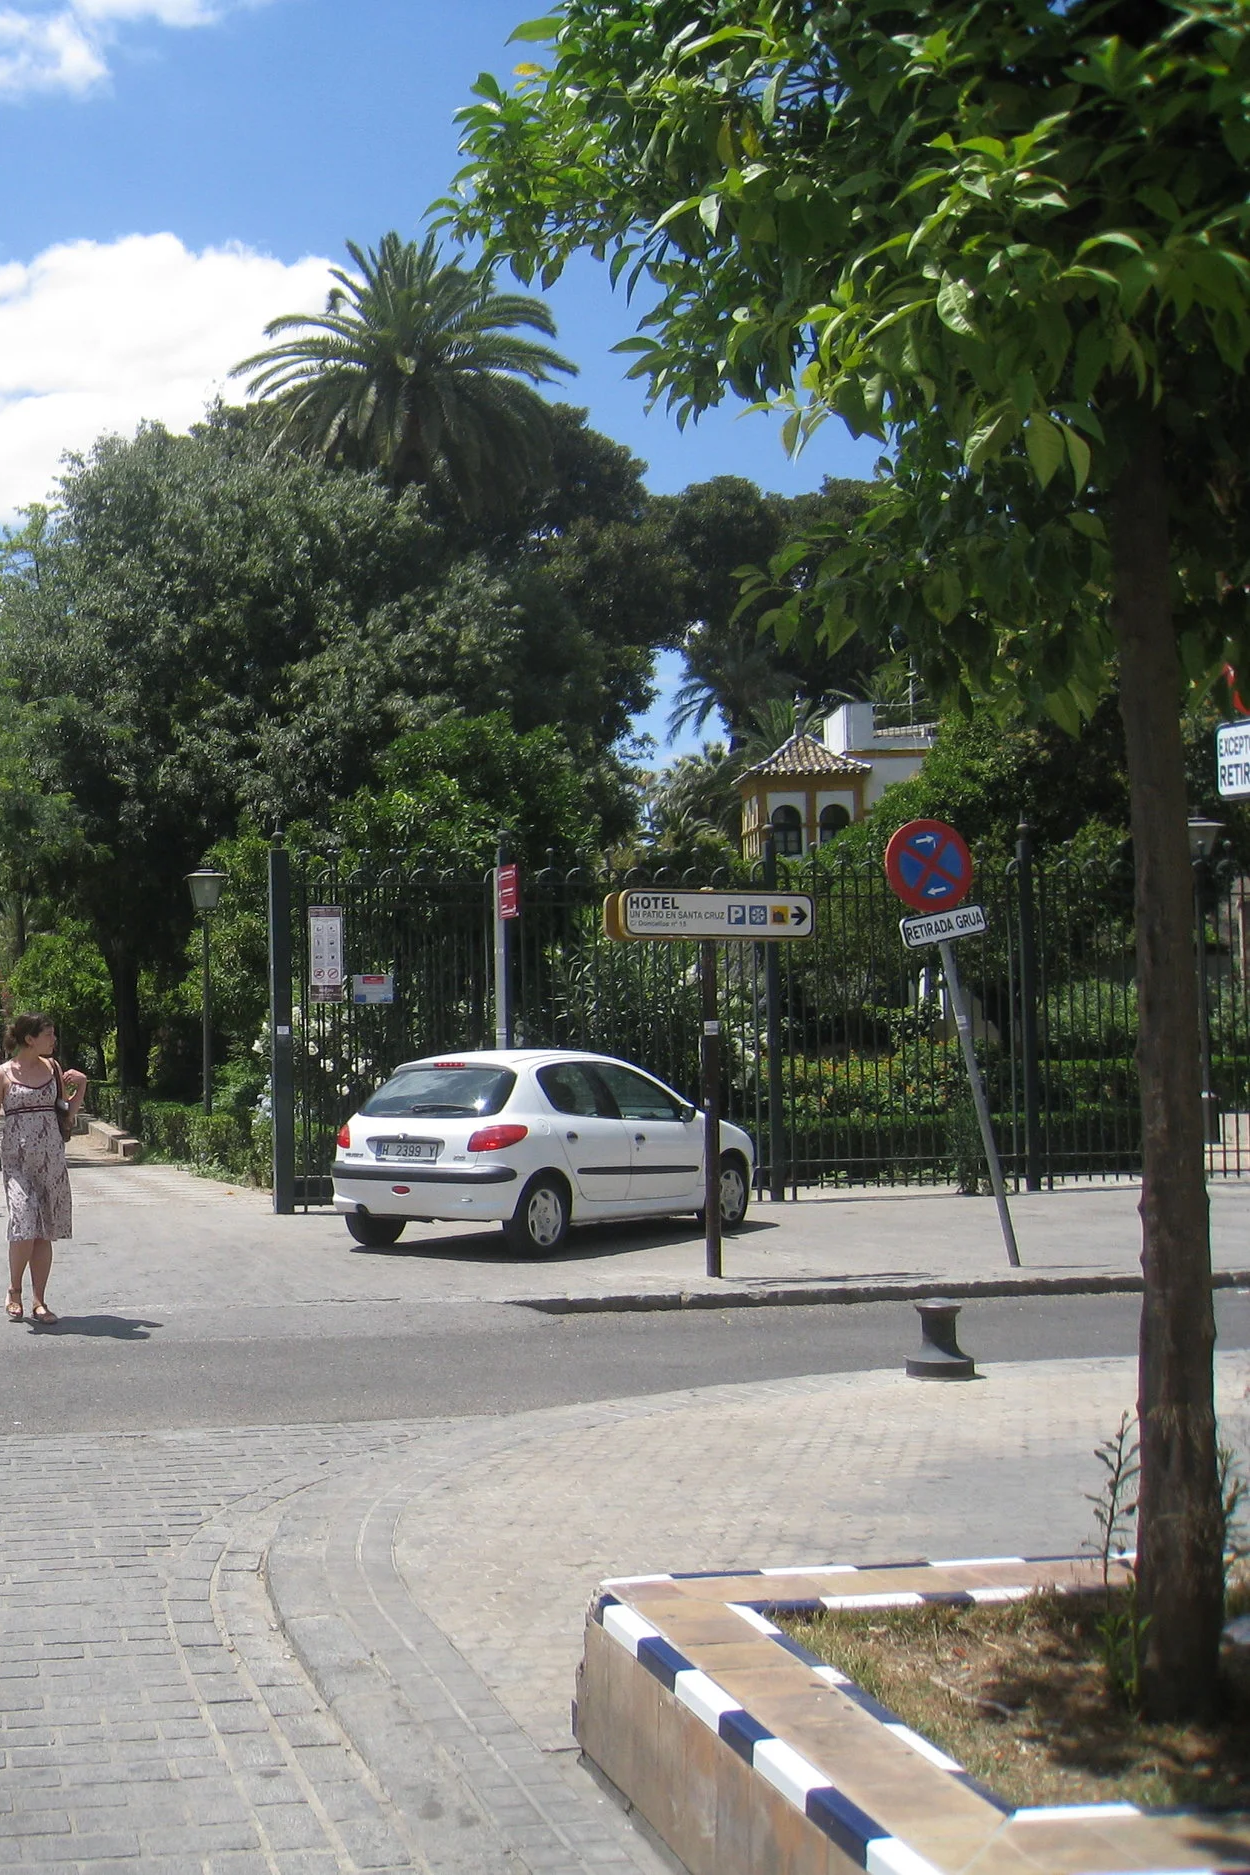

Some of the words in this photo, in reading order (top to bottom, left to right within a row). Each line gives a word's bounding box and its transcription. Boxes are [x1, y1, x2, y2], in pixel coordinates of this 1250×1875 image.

[1219, 735, 1250, 758] EXCEPT
[630, 896, 680, 910] HOTEL
[642, 911, 664, 919] PATIO
[666, 911, 676, 919] EN
[678, 912, 703, 920] SANTA
[704, 912, 725, 920] CRUZ
[906, 918, 955, 941] RETIRADA
[955, 911, 984, 929] GRUA
[382, 1144, 390, 1155] H
[395, 1144, 422, 1157] 2399
[429, 1146, 436, 1157] Y
